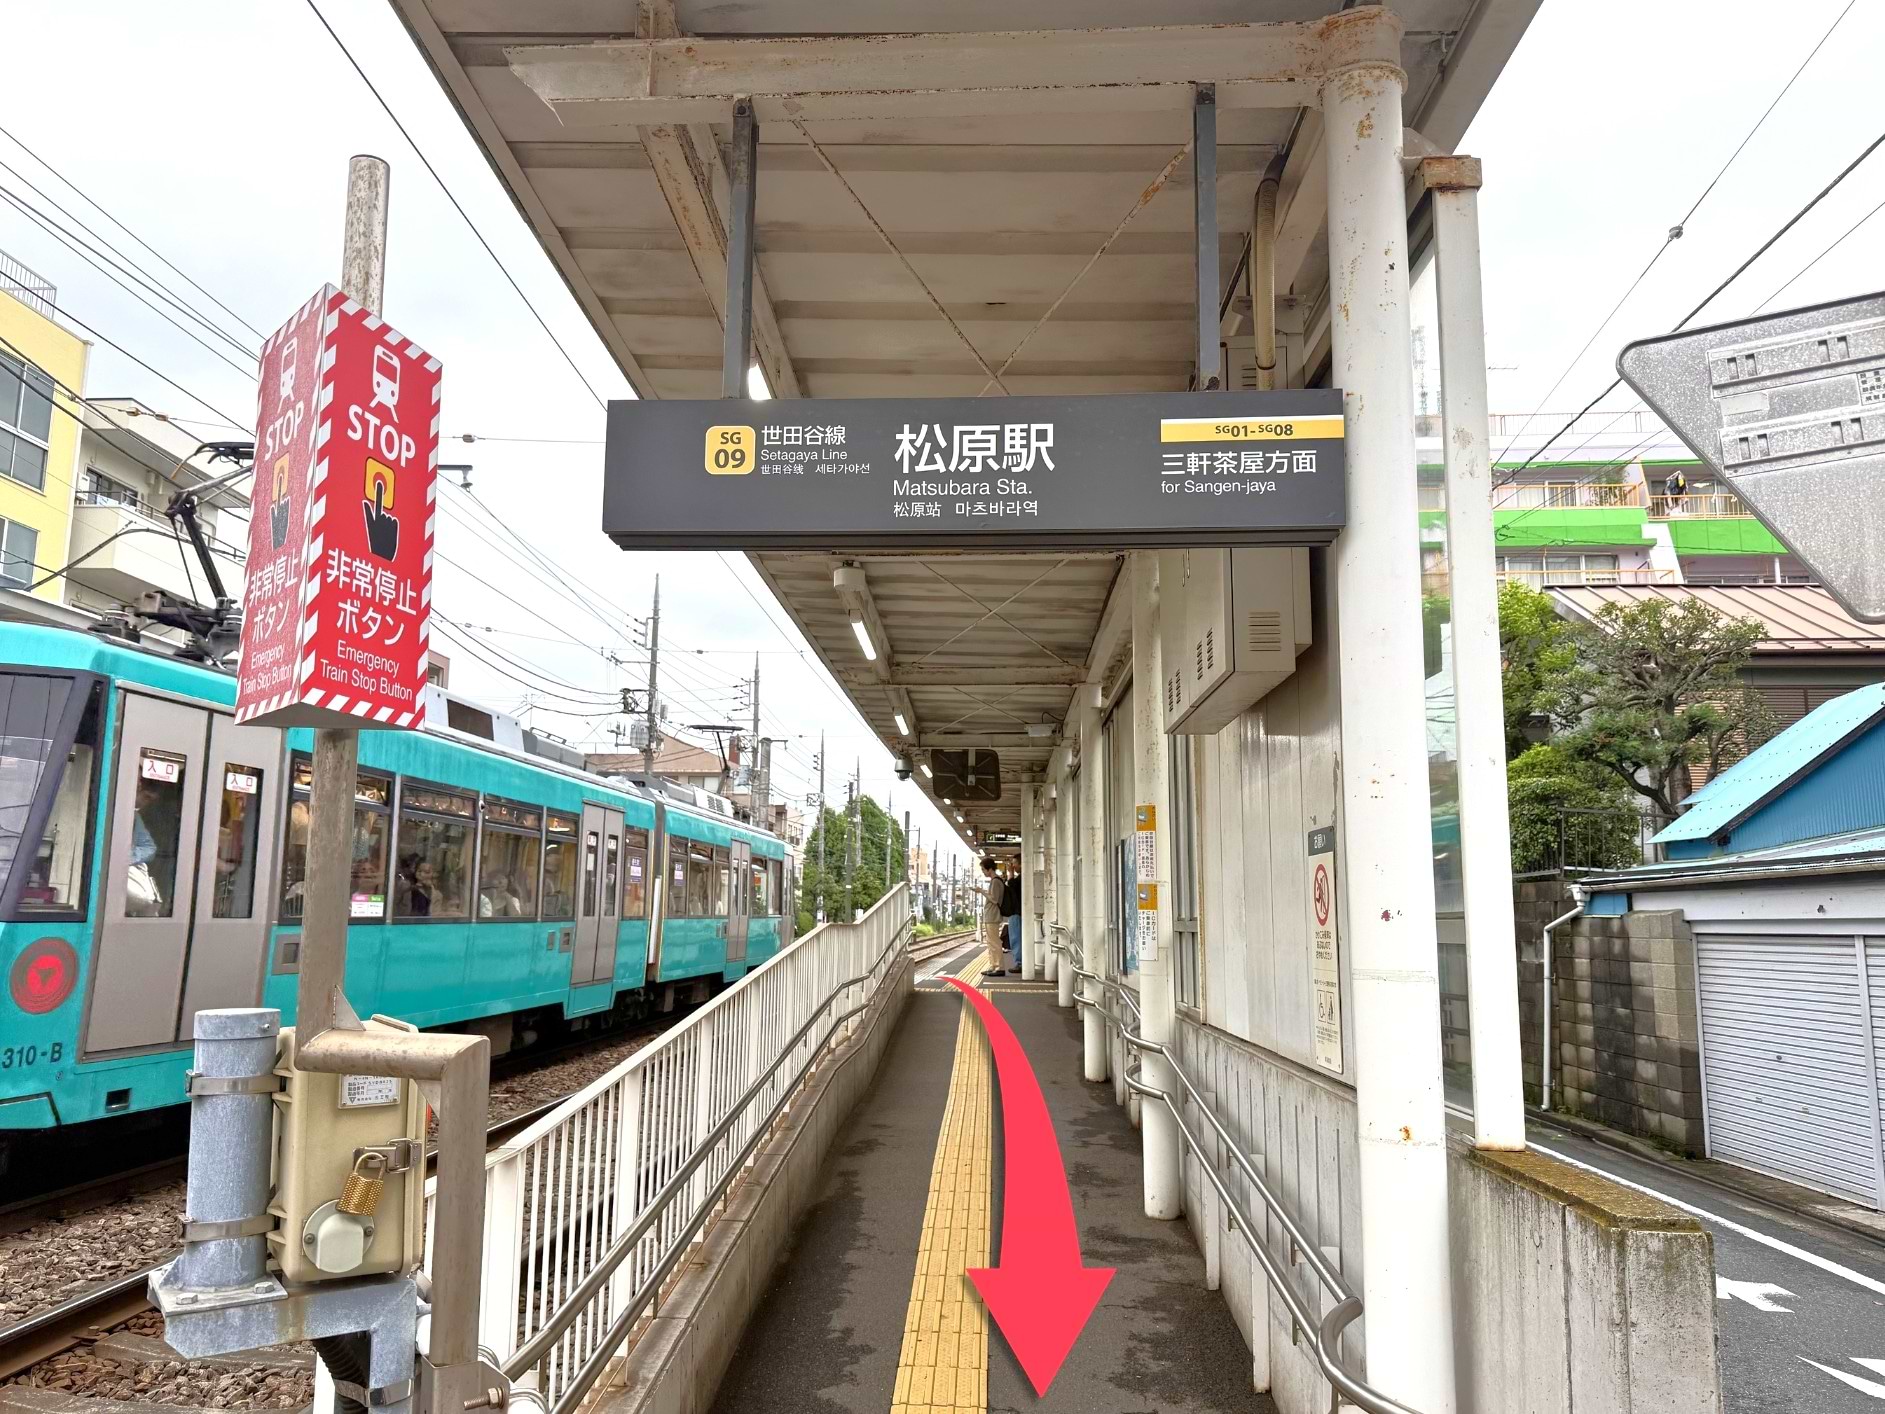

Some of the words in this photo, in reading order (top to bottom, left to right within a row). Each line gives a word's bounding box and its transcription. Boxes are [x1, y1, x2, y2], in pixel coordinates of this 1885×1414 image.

[264, 400, 305, 461] STOP
[347, 404, 416, 468] STOP
[720, 431, 742, 445] SG
[761, 425, 847, 446] 世田谷線
[714, 448, 746, 469] 09
[760, 449, 818, 463] Setagaya
[822, 448, 848, 460] Line
[894, 423, 1056, 474] 松原駅
[1161, 450, 1317, 475] 三軒茶屋方面
[893, 479, 991, 496] Matsubara
[996, 478, 1033, 495] Sta.
[1160, 481, 1180, 493] for
[1184, 479, 1277, 496] Sangen-jaya
[893, 501, 942, 518] 松原站
[955, 500, 1038, 517] 마츠바라역
[249, 554, 298, 607] 非常停止
[326, 547, 417, 616] 非常停止
[252, 599, 291, 643] ボタン
[336, 599, 405, 646] ボタン
[251, 643, 285, 670] Emergency
[337, 640, 400, 679] Emergency
[243, 677, 256, 695] Train
[257, 671, 271, 692] Stop
[271, 664, 292, 685] Button
[320, 659, 348, 684] Train
[351, 667, 376, 695] Stop
[380, 675, 413, 701] Button
[1, 1042, 63, 1069] 310-B
